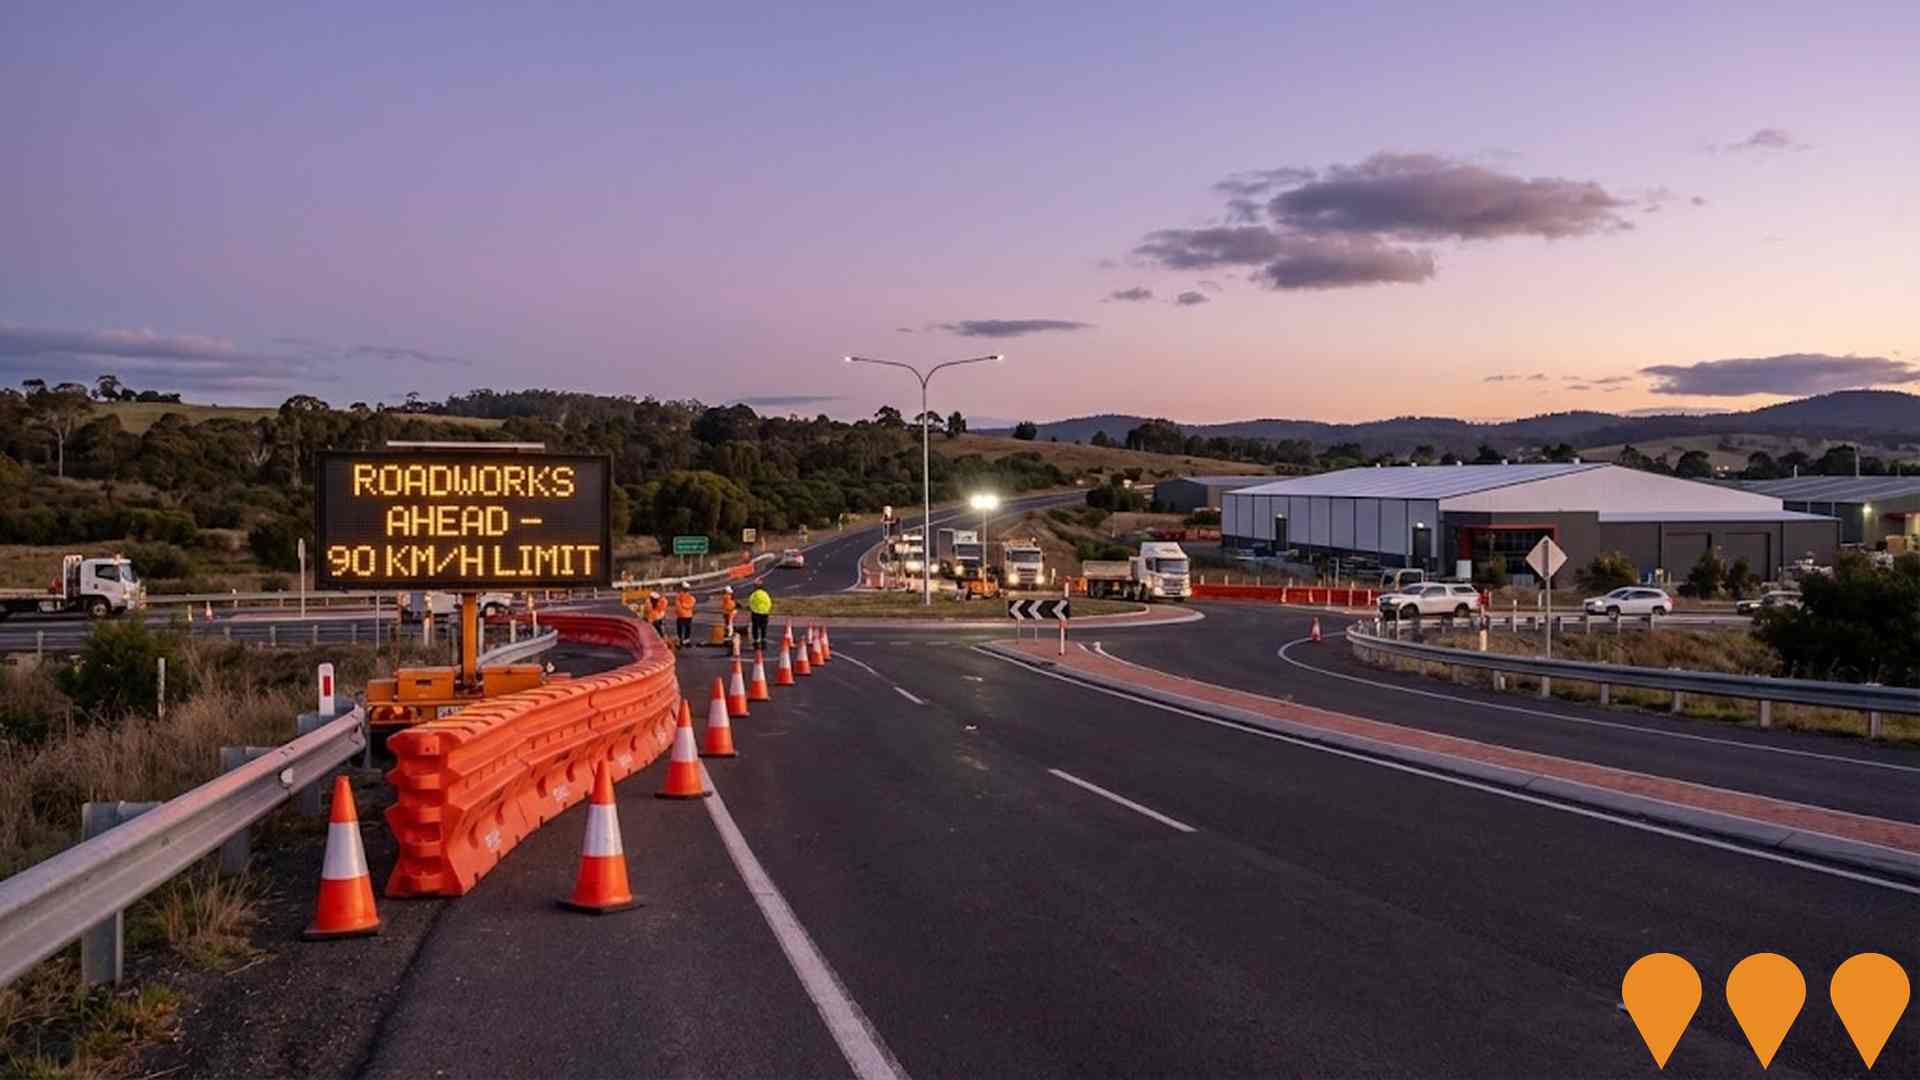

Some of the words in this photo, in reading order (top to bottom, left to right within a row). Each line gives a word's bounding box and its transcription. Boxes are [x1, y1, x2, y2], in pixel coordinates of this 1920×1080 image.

[353, 464, 575, 497] ROADWORKS
[386, 505, 509, 536] AHEAD
[519, 517, 543, 525] -
[327, 545, 377, 576] 90
[385, 545, 485, 577] KM/H
[493, 545, 600, 576] LIMIT
